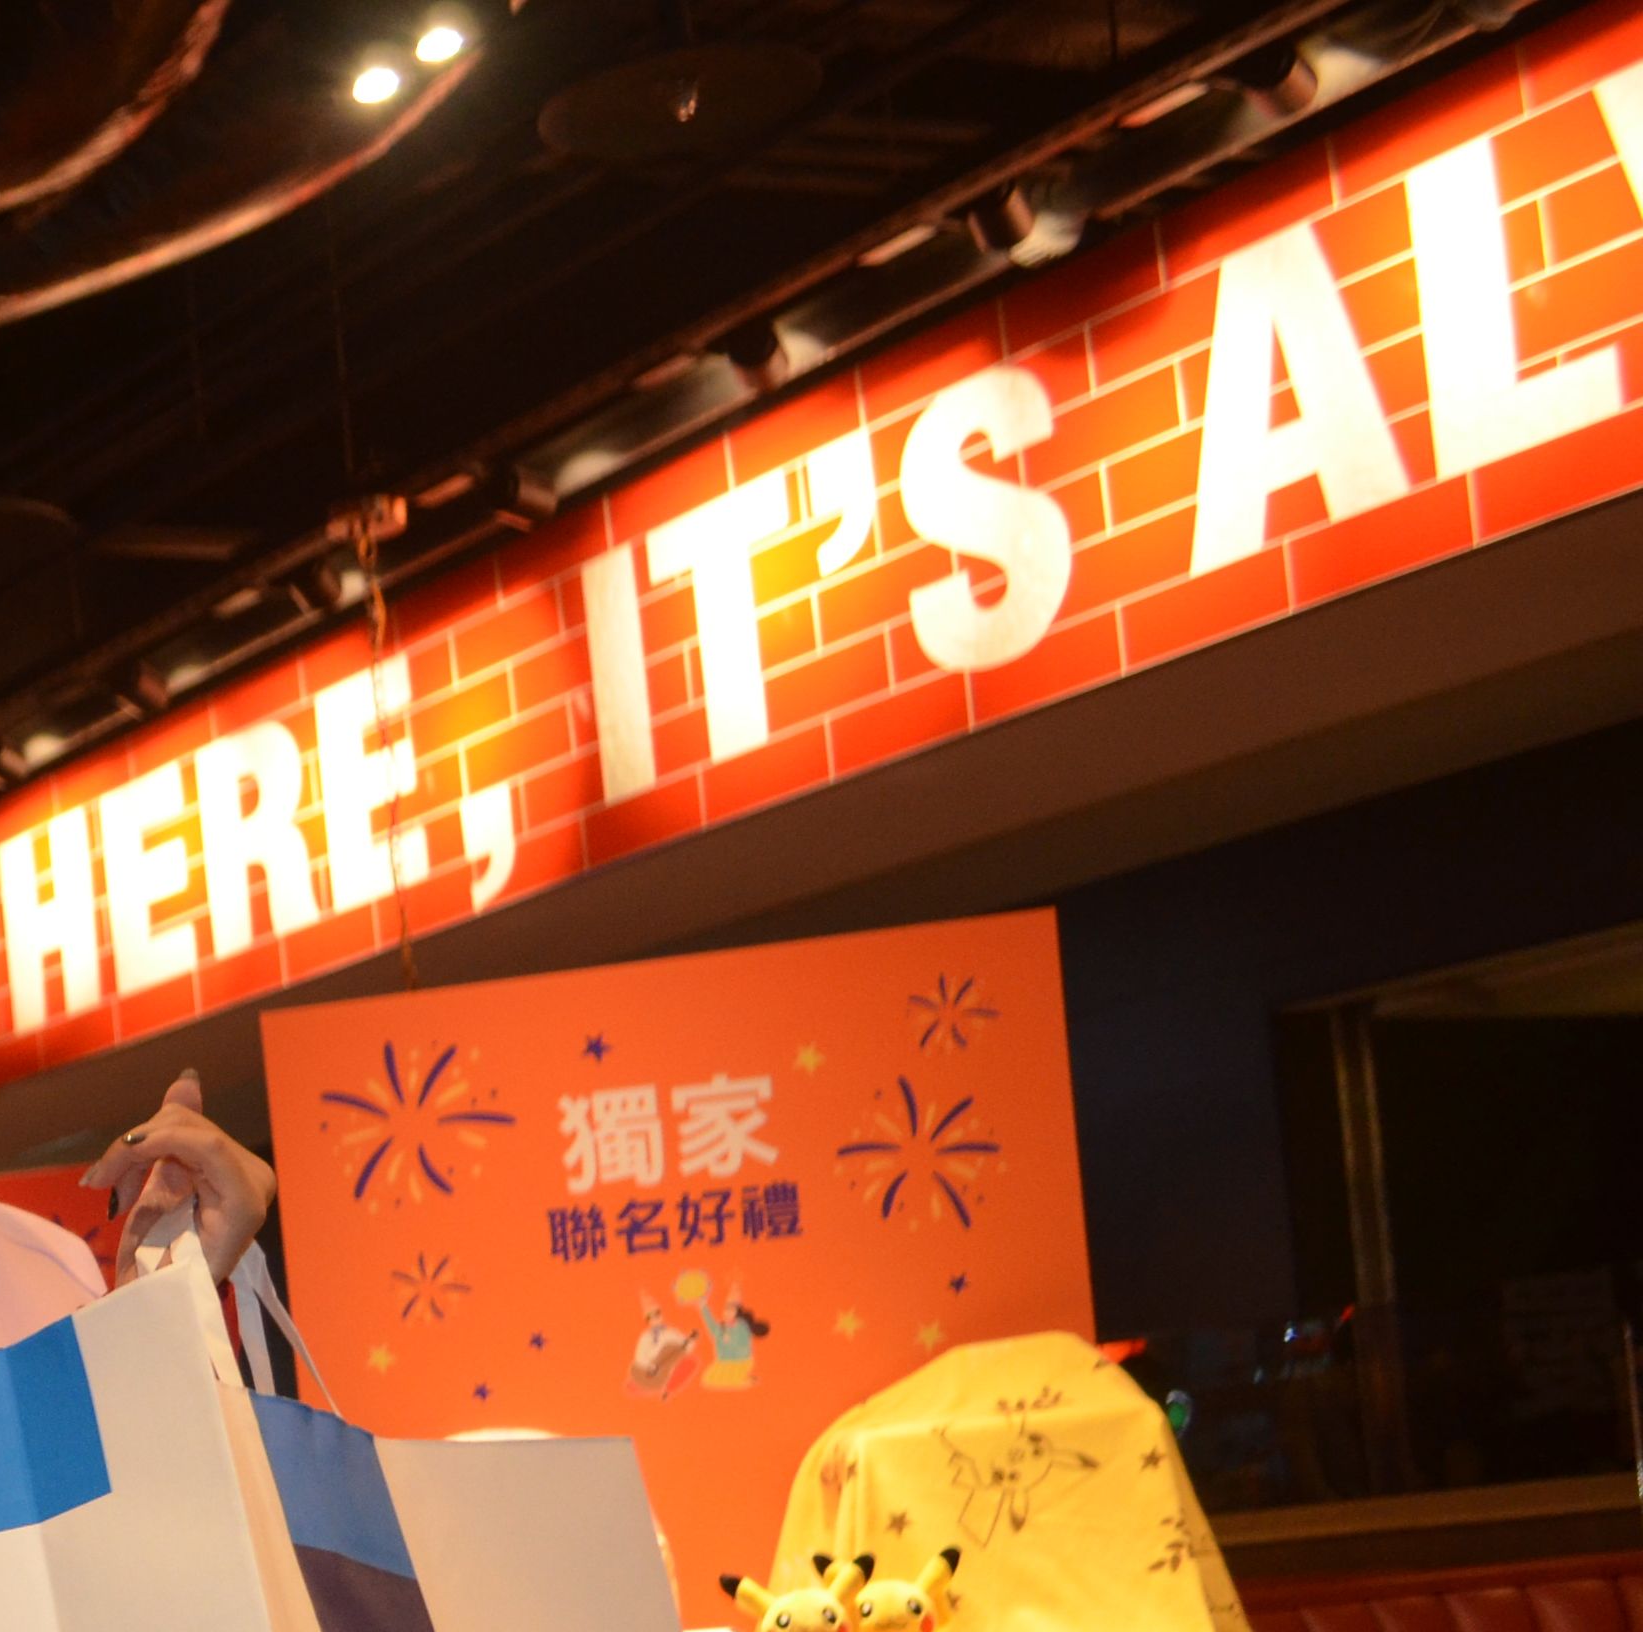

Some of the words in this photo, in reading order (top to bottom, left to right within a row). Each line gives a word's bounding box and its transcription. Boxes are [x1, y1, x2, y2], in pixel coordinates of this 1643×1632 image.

[580, 367, 1072, 806] IT'S
[1187, 61, 1643, 578] AL
[558, 1073, 779, 1193] 獨家
[547, 1181, 802, 1262] 聯名好禮
